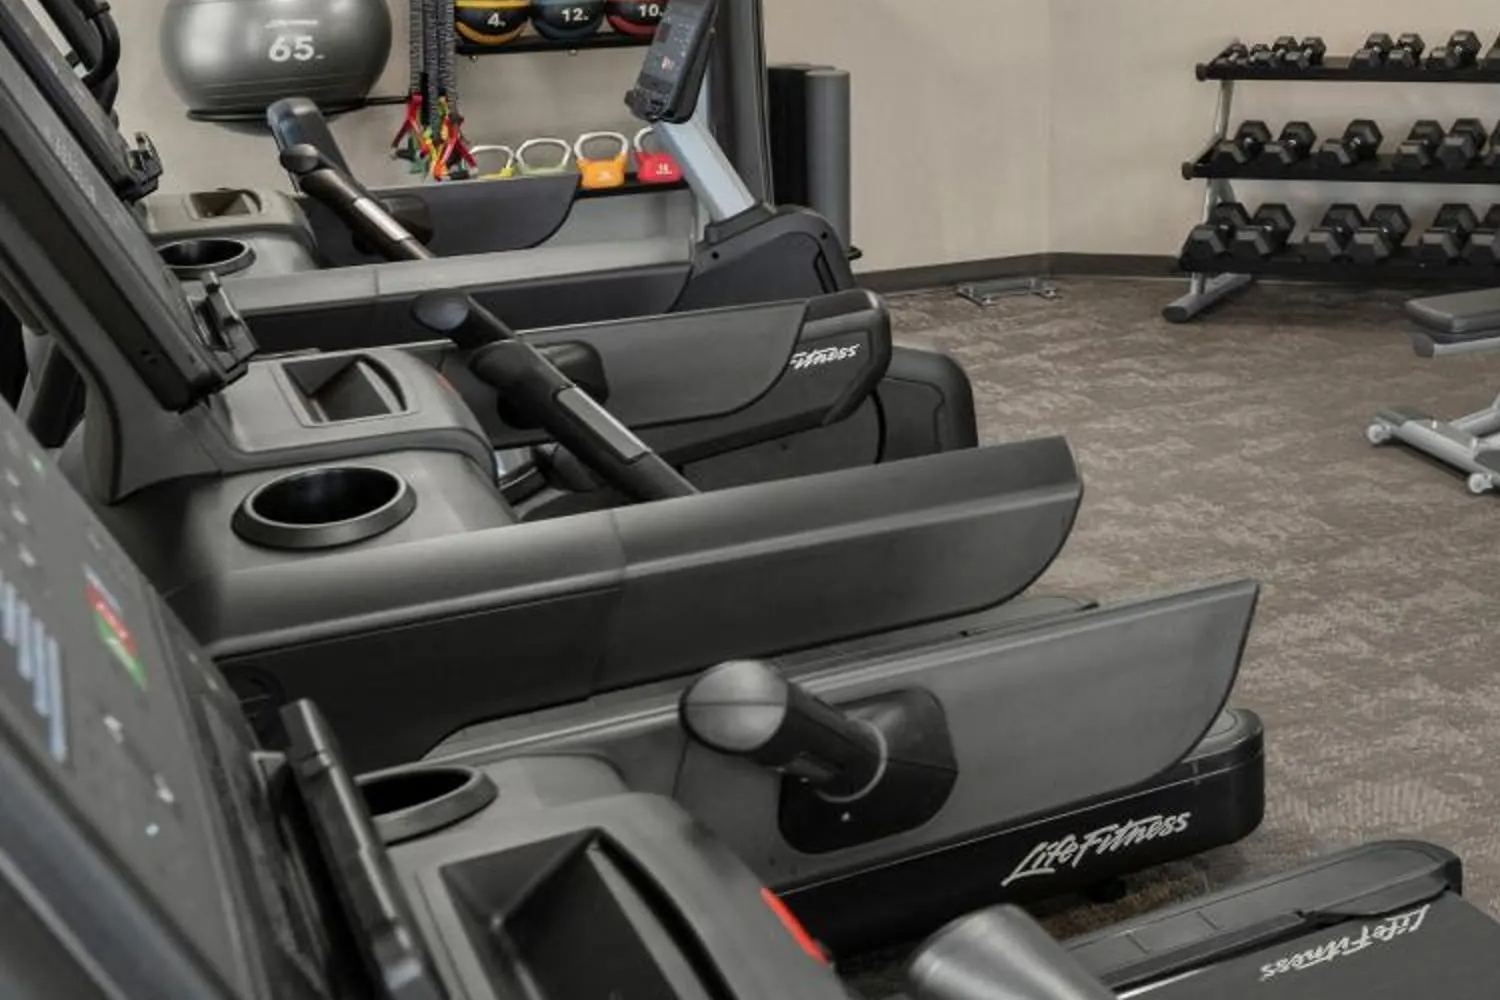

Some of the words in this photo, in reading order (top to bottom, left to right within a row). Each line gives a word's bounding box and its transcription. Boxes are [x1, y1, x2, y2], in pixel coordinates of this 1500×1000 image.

[561, 7, 583, 22] 12
[638, 4, 659, 17] 10
[487, 12, 500, 27] 4
[269, 35, 315, 61] 65
